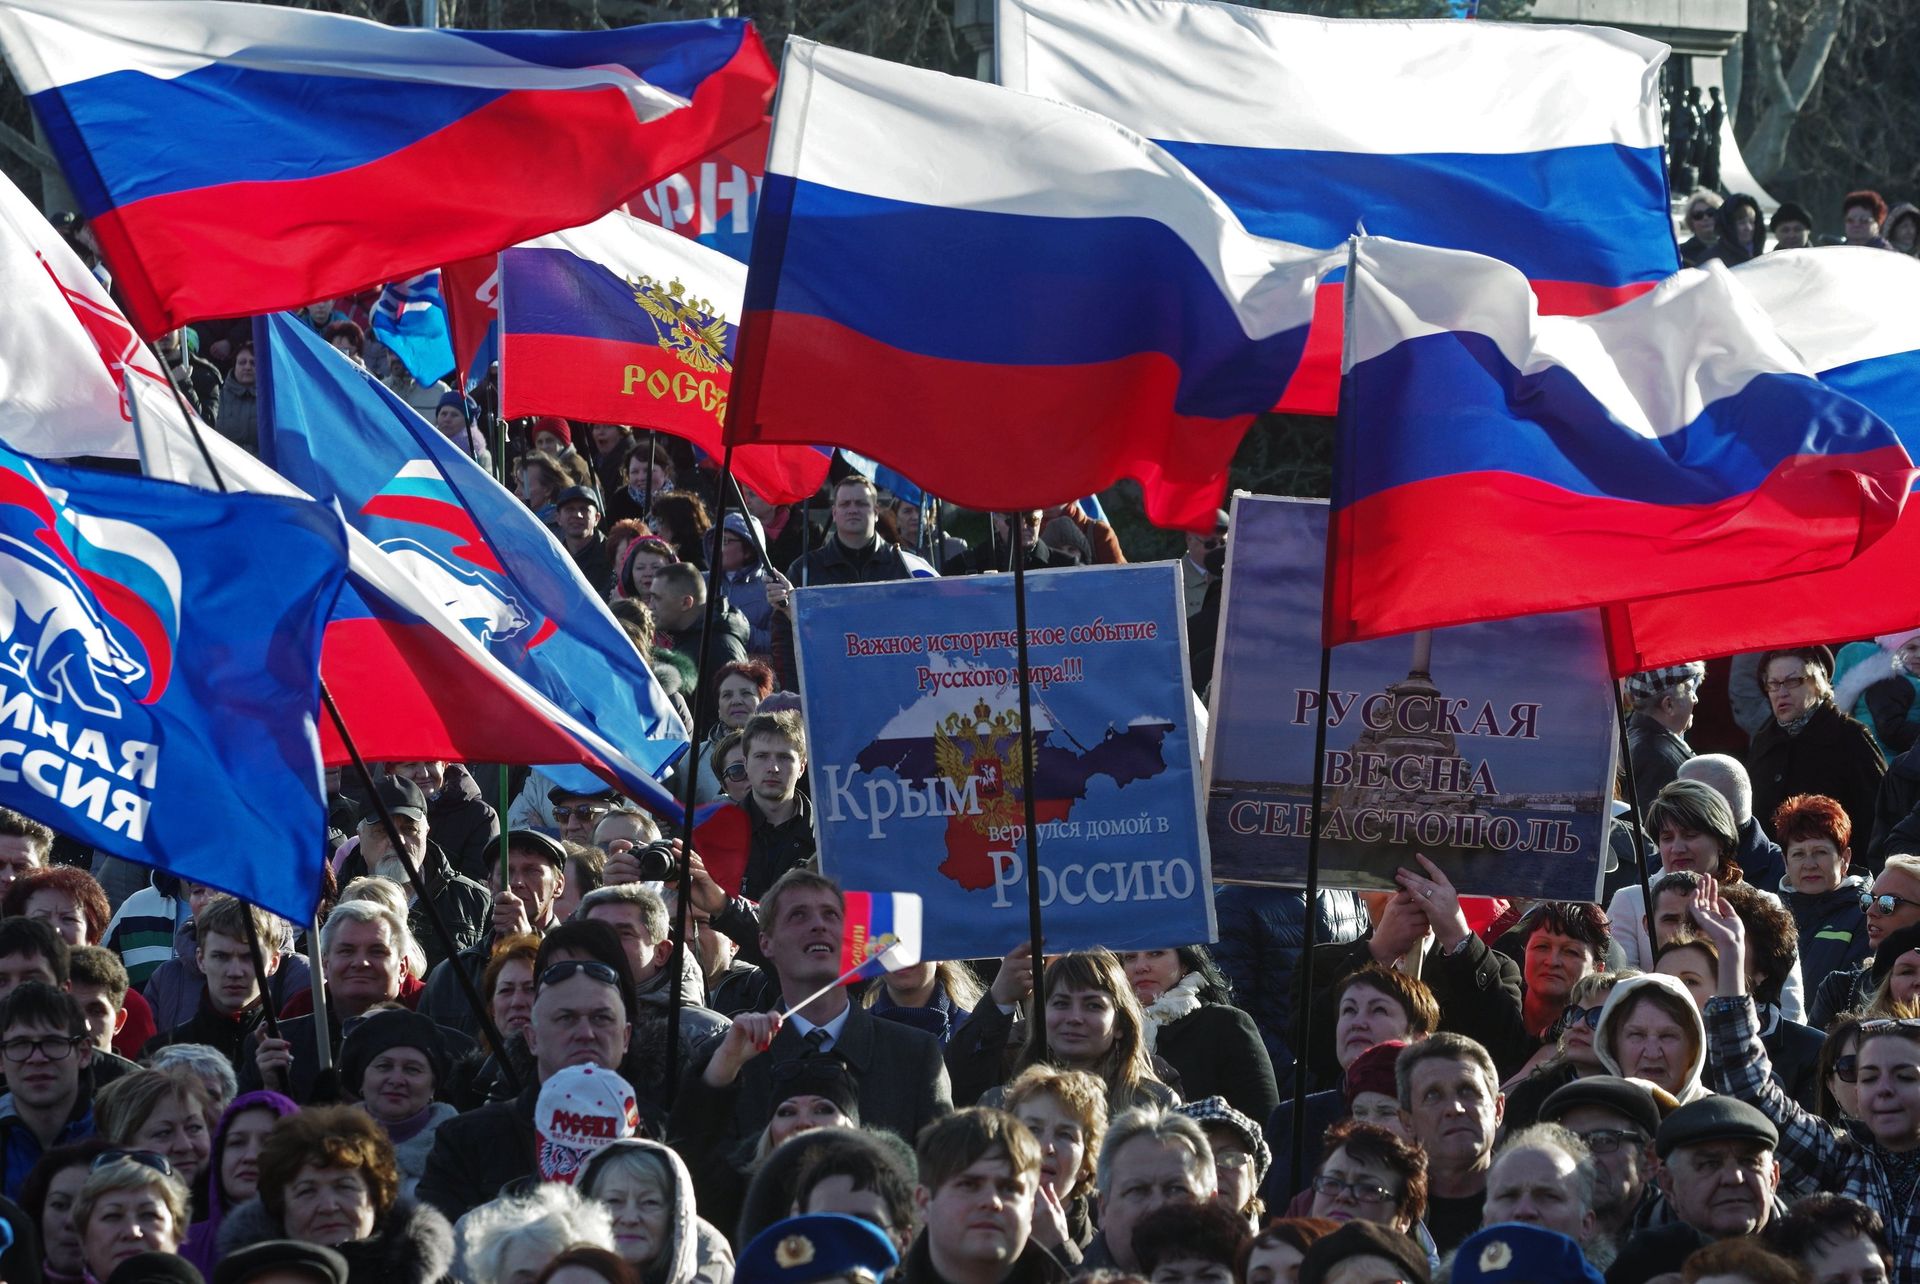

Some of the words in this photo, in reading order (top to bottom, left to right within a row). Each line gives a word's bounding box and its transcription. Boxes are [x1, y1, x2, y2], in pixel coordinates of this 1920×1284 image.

[643, 163, 763, 234] ФН
[845, 632, 922, 657] Важное
[1070, 616, 1158, 643] событие
[917, 665, 1008, 696] Русского
[1290, 688, 1543, 740] РУССКАЯ
[1322, 749, 1499, 797] ВЕСНА
[822, 762, 983, 840] Крым
[988, 819, 1082, 848] верулся
[1086, 811, 1152, 841] домой
[1157, 817, 1169, 833] в
[1228, 800, 1582, 855] СЕВАСТОПОЛЬ
[987, 850, 1195, 908] Россию
